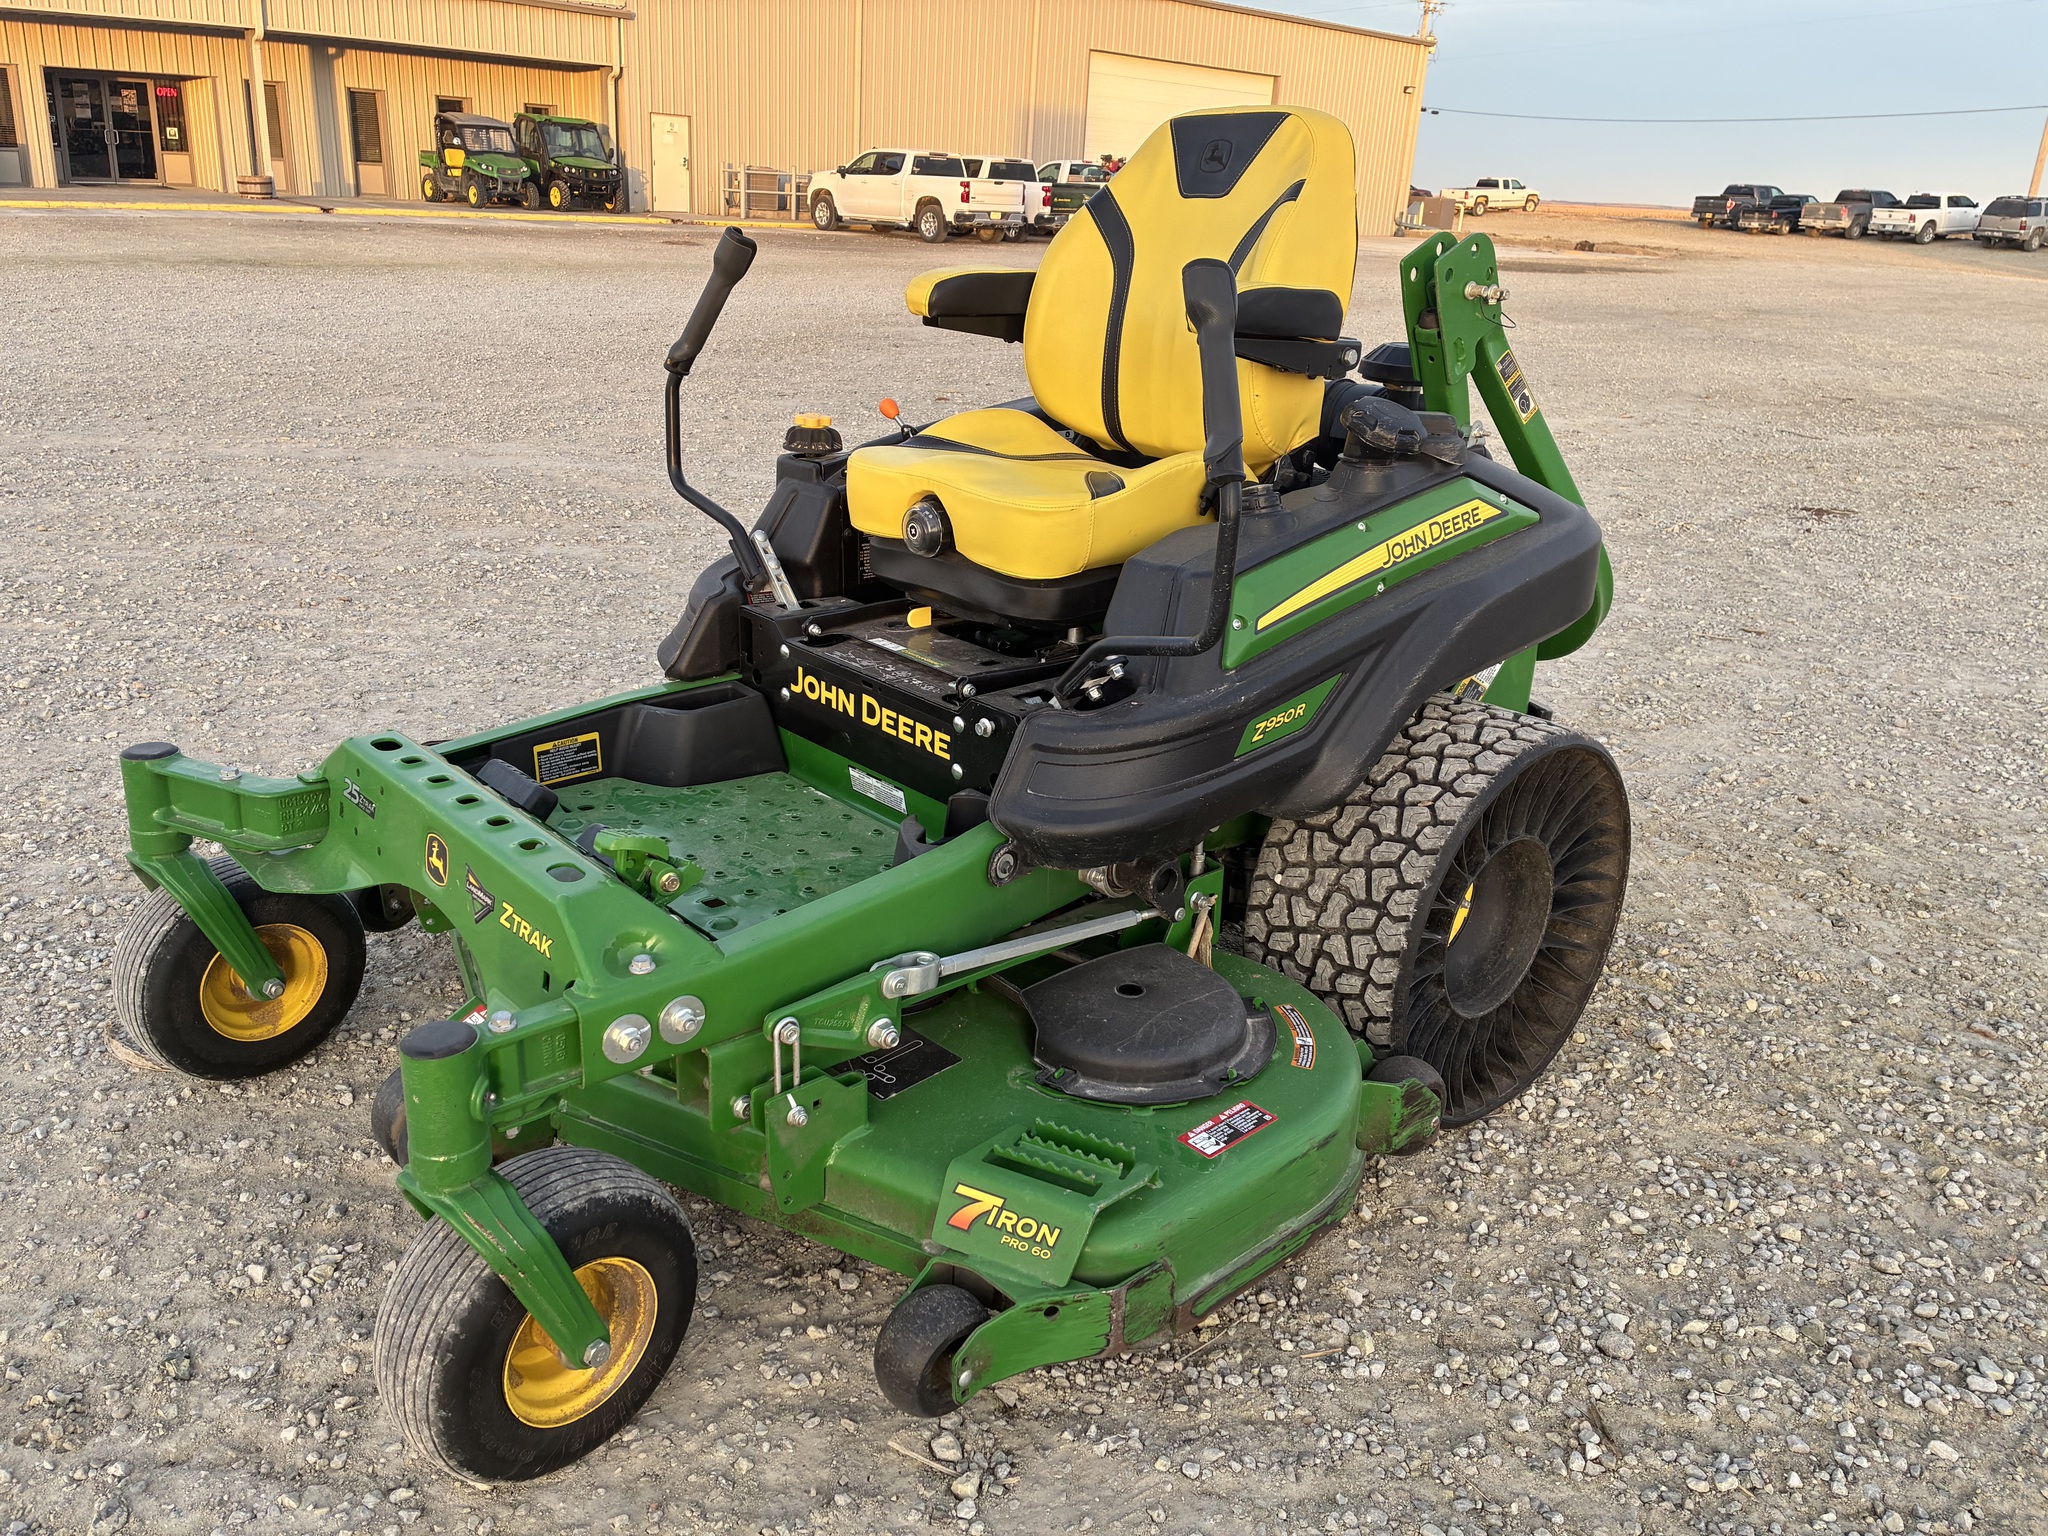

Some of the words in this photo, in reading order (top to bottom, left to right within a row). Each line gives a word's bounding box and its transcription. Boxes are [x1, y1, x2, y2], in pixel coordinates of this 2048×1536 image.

[156, 87, 177, 97] OPEN
[1383, 531, 1427, 566] JOHN
[1429, 506, 1482, 542] DEERE
[790, 665, 854, 718] JOHN
[862, 693, 951, 761] DEERE
[1251, 703, 1306, 743] Z950R
[557, 738, 578, 747] CAUTION
[343, 777, 360, 804] 25
[500, 901, 553, 959] ZTRAK
[1223, 1102, 1246, 1117] PELIGRO
[1192, 1120, 1216, 1134] DANGER
[1000, 1235, 1029, 1252] PRO
[1031, 1246, 1052, 1260] 60
